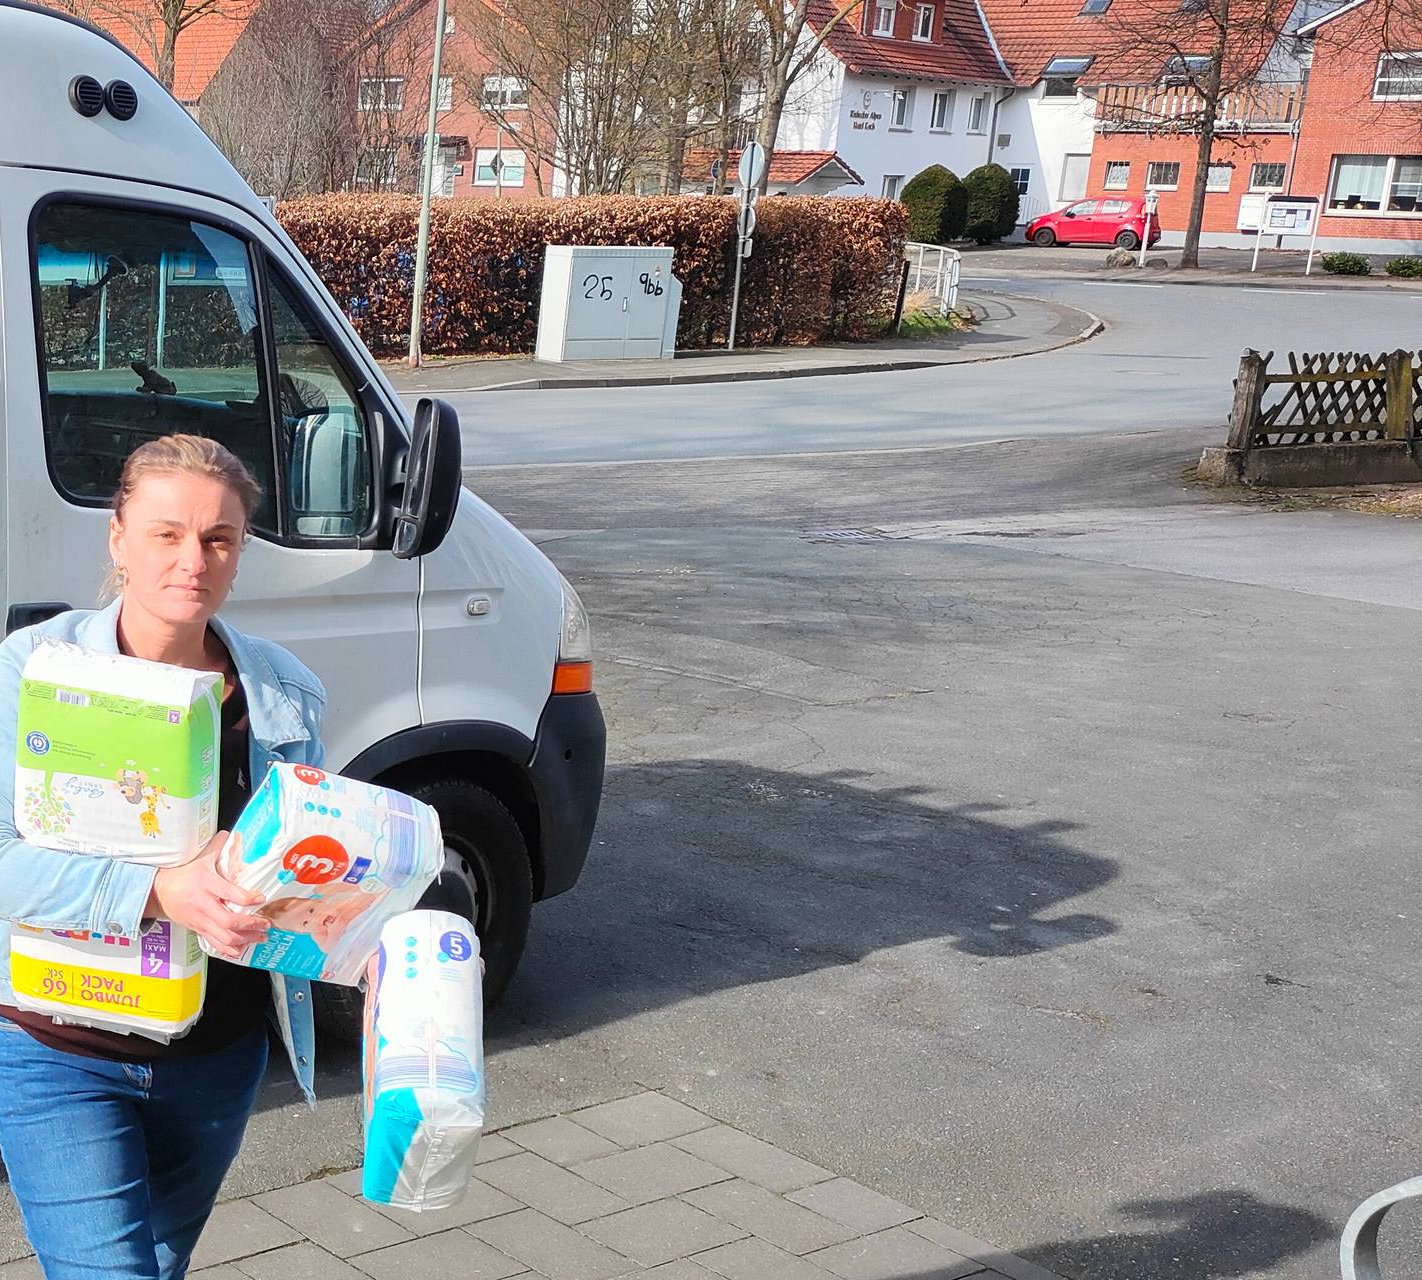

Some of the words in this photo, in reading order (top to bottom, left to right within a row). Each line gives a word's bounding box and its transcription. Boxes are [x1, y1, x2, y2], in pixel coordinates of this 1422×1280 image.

[300, 769, 319, 779] 3
[296, 854, 335, 875] 3
[145, 944, 167, 953] MAXI
[253, 931, 283, 966] PREMIUM
[265, 934, 296, 969] WINDELN
[450, 937, 463, 955] 5
[147, 952, 164, 974] 4
[44, 967, 64, 979] Stk.
[42, 977, 68, 996] 66
[80, 974, 124, 992] PACK
[80, 989, 141, 1008] JUMBO
